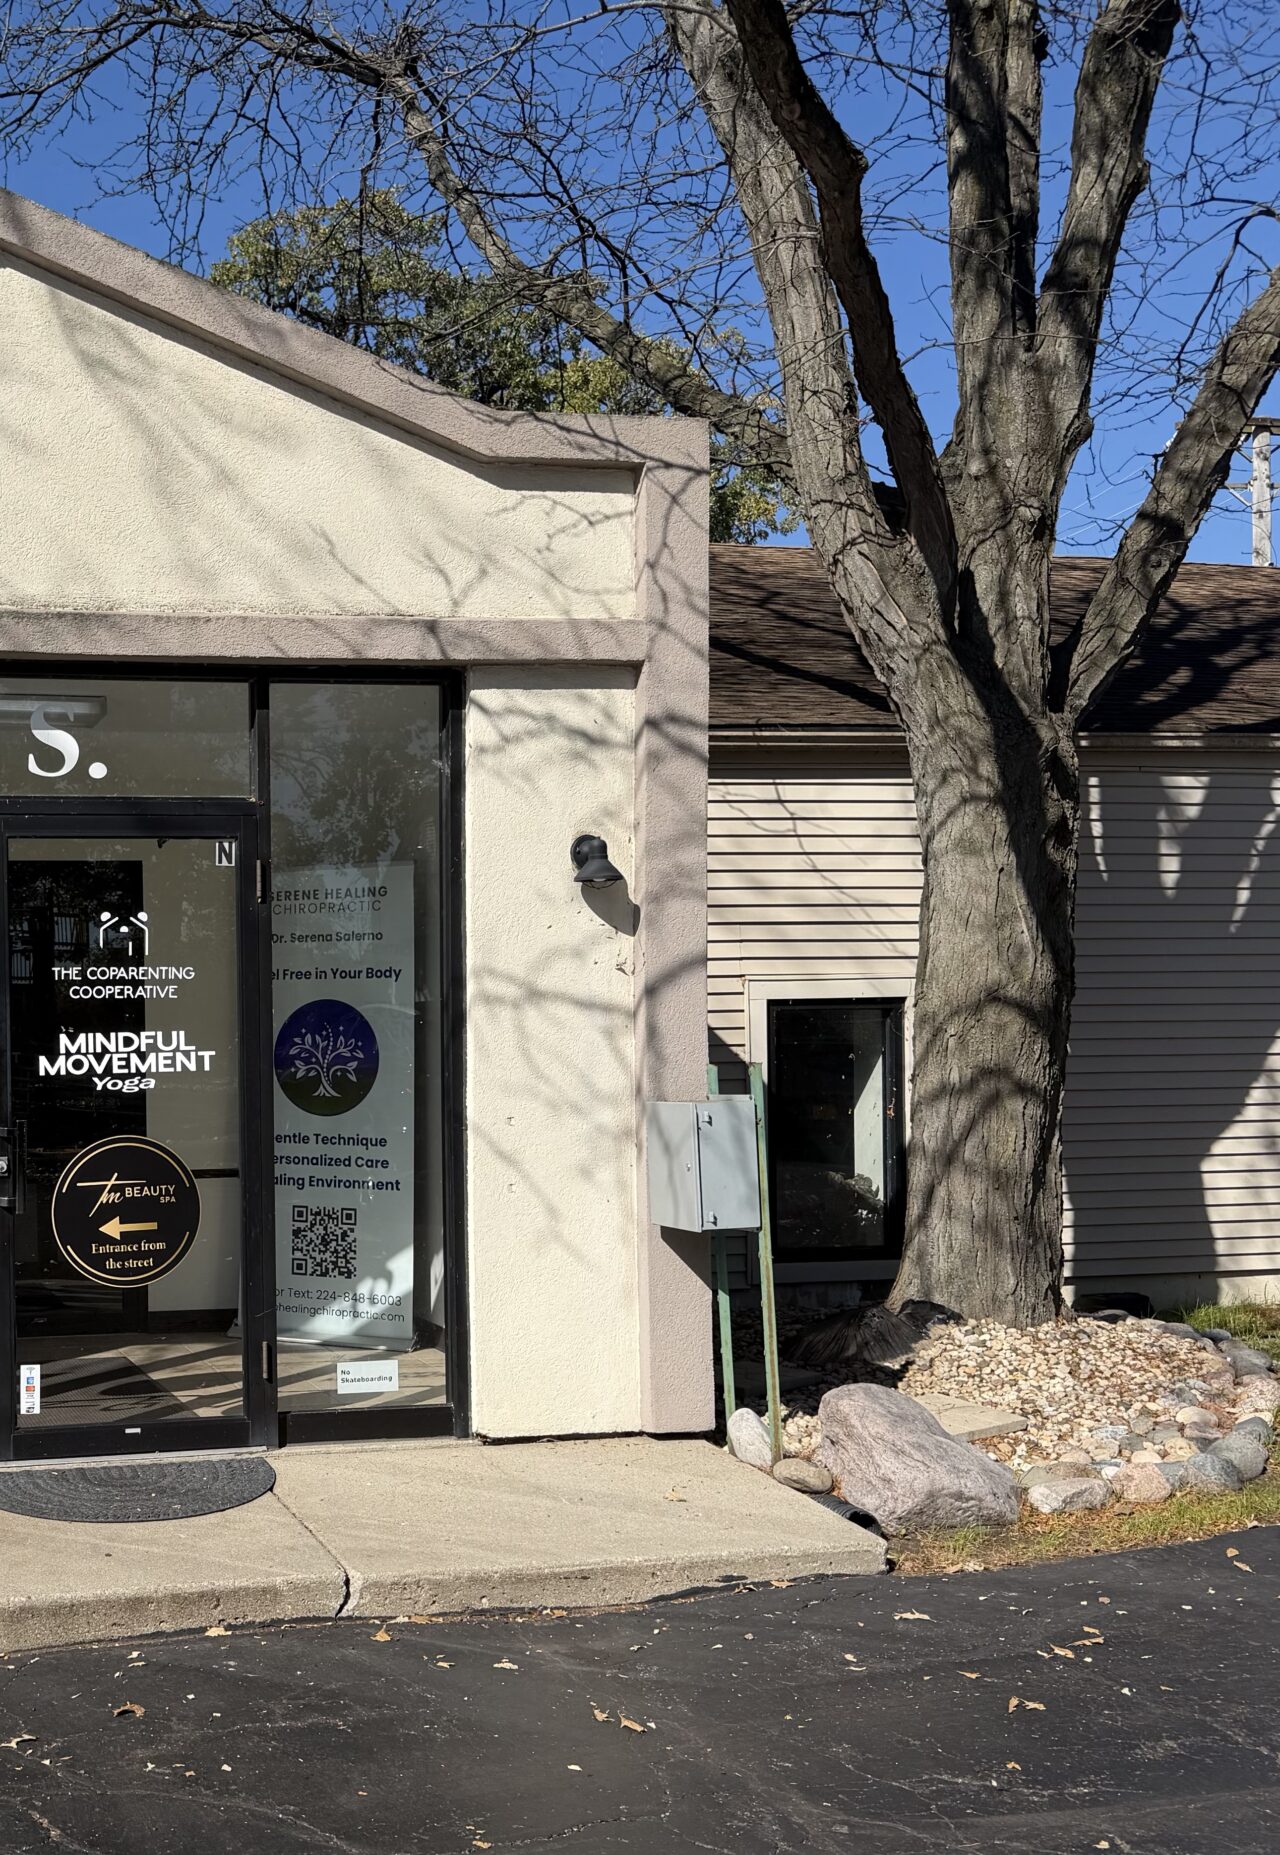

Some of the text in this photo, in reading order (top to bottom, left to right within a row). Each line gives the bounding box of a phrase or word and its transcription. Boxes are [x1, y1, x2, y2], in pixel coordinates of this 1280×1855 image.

[28, 703, 108, 779] S.
[218, 842, 234, 865] N
[324, 886, 388, 898] HEALING
[272, 900, 382, 915] CHIROPRACTIC
[271, 930, 384, 944] Dr. Serena Salerno
[51, 967, 196, 981] THE COPARENTING
[271, 966, 402, 982] el Free in Your Body
[69, 985, 178, 999] COOPERATIVE
[59, 1030, 196, 1054] MINDFUL
[38, 1051, 216, 1077] MOVEMENT
[92, 1076, 156, 1093] Yoga
[274, 1132, 388, 1150] entle Technique
[273, 1154, 390, 1169] ersonalized Care
[274, 1173, 401, 1191] aling Environment
[125, 1184, 176, 1198] BEAUTY
[159, 1196, 176, 1204] SPA
[91, 1240, 166, 1254] Entrance from
[105, 1257, 154, 1270] the street
[287, 1287, 313, 1300] Text:
[316, 1289, 402, 1307] 224-848-6003
[340, 1375, 393, 1384] Skateboarding
